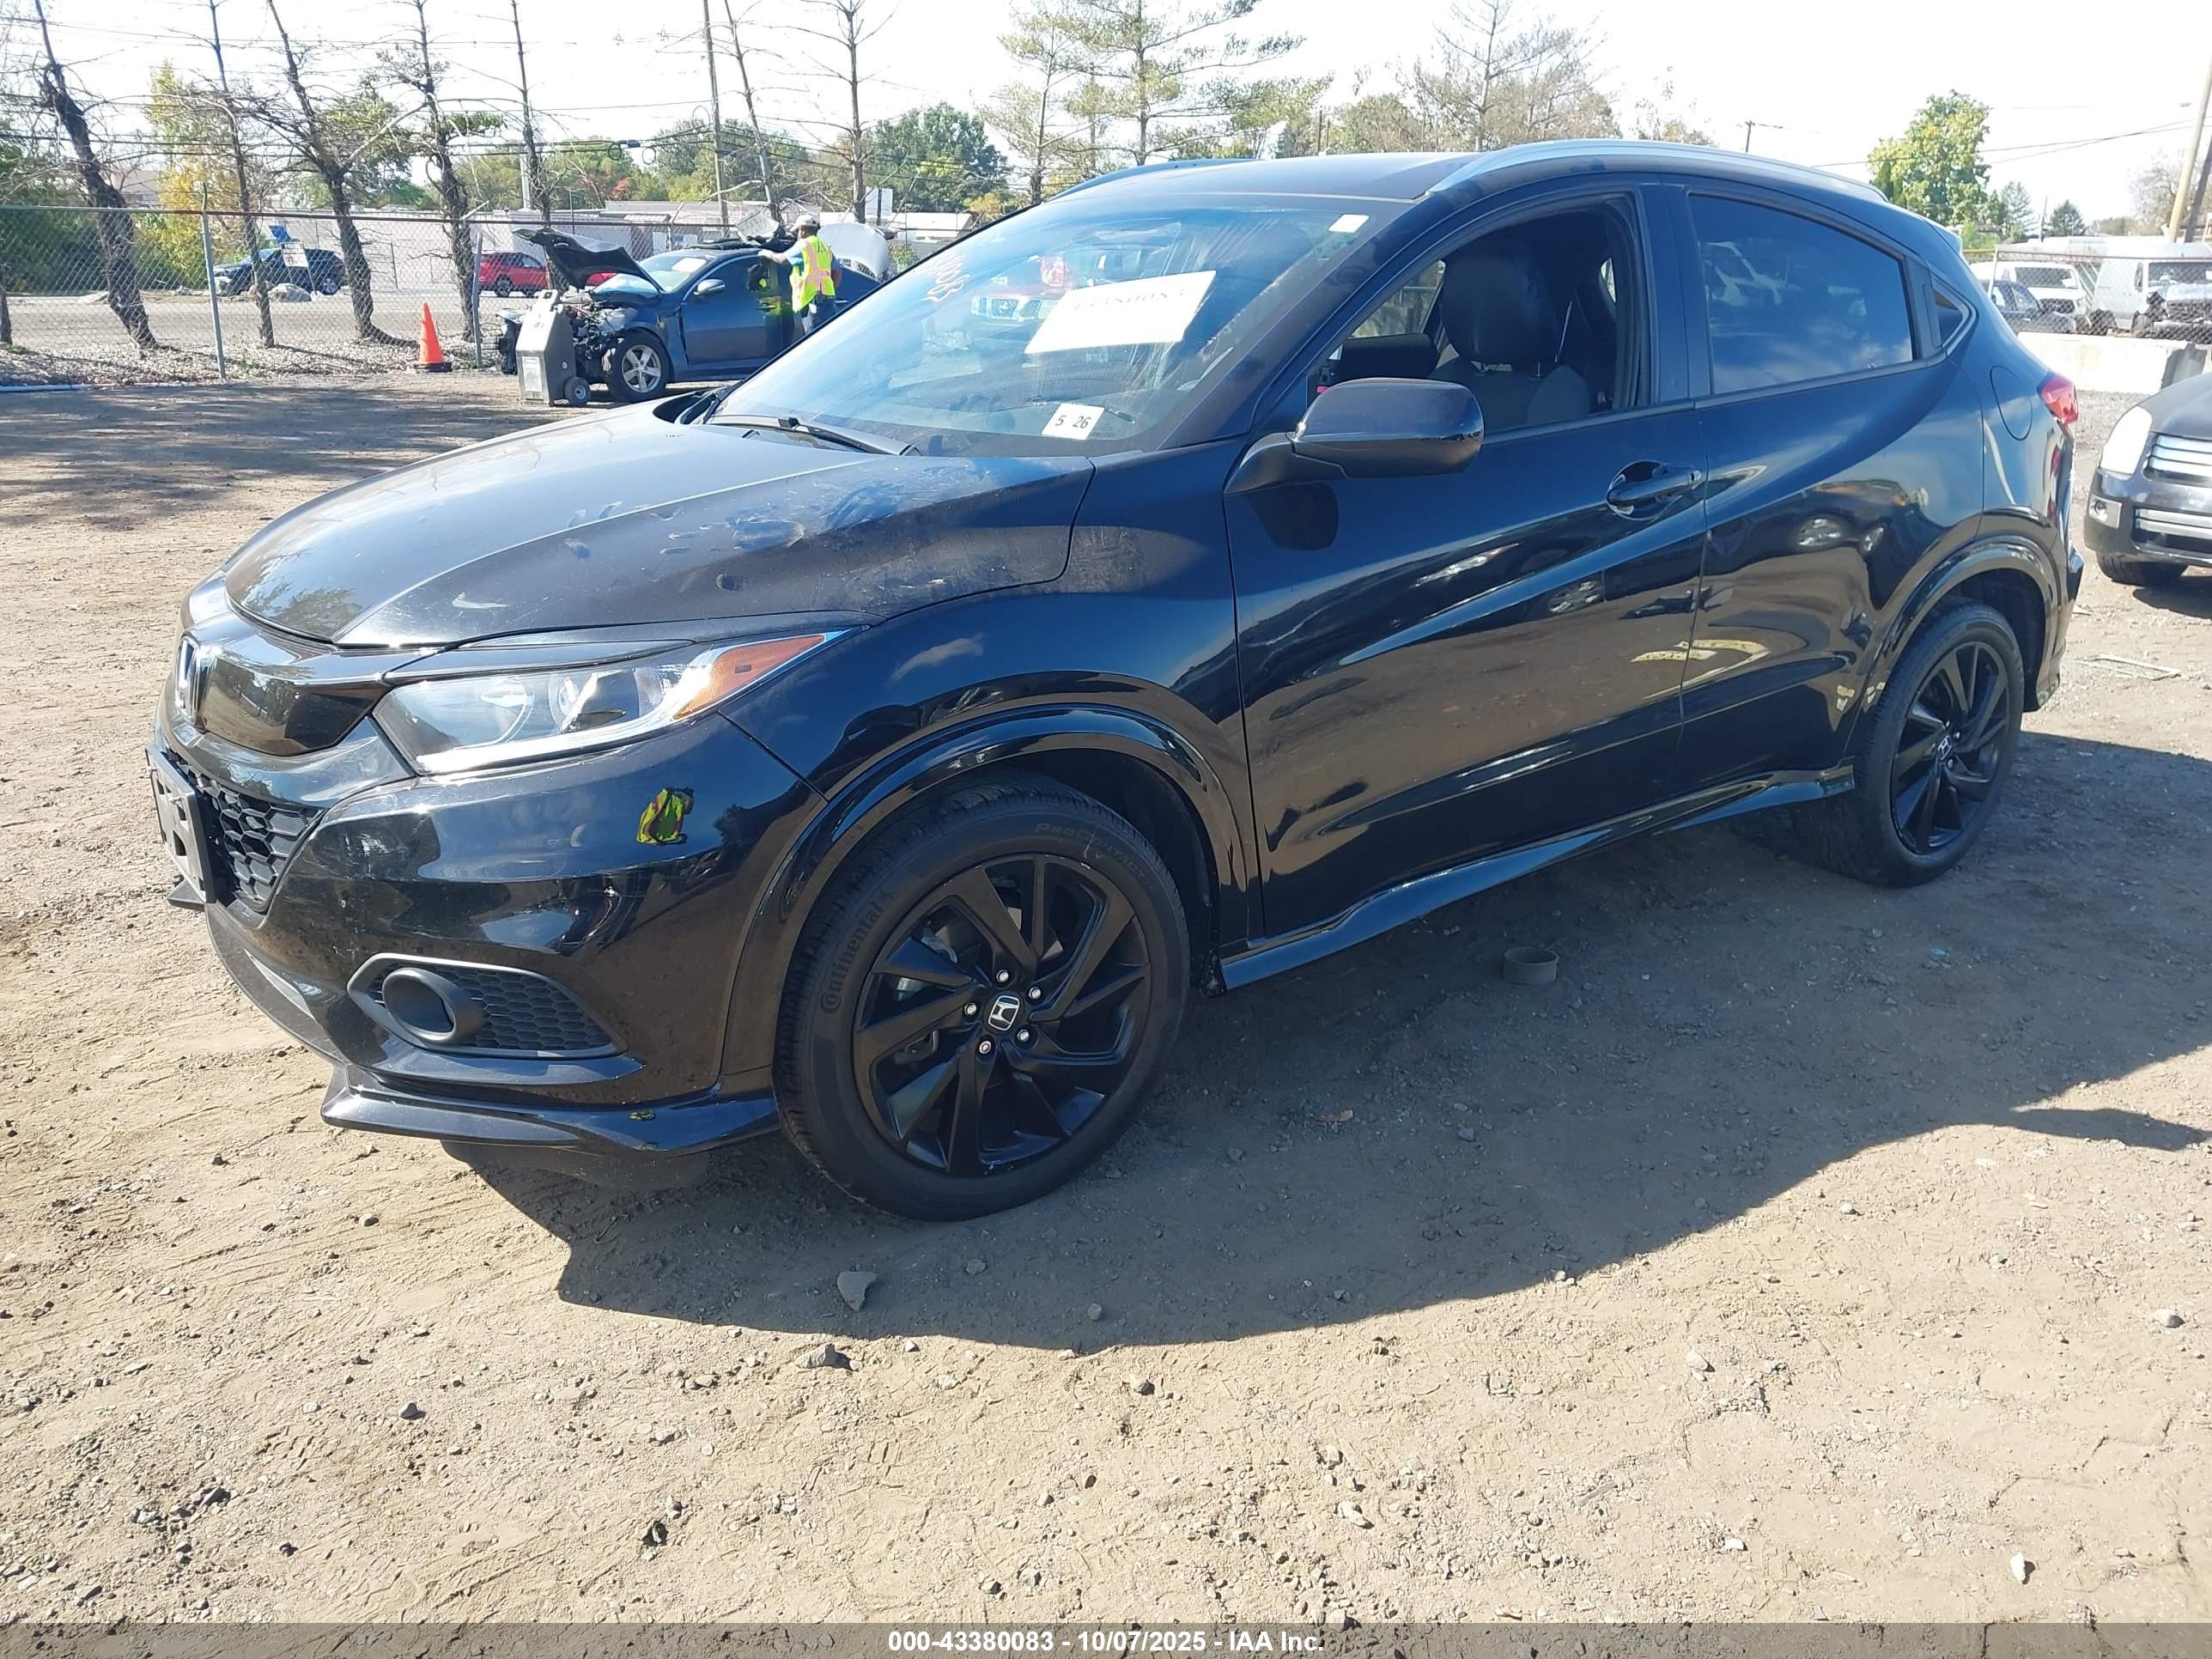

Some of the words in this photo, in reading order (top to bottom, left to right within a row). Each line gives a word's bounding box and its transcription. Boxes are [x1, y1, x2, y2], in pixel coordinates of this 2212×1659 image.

[1054, 415, 1066, 427] 5
[1072, 415, 1091, 428] 26
[820, 899, 885, 1014] Continental
